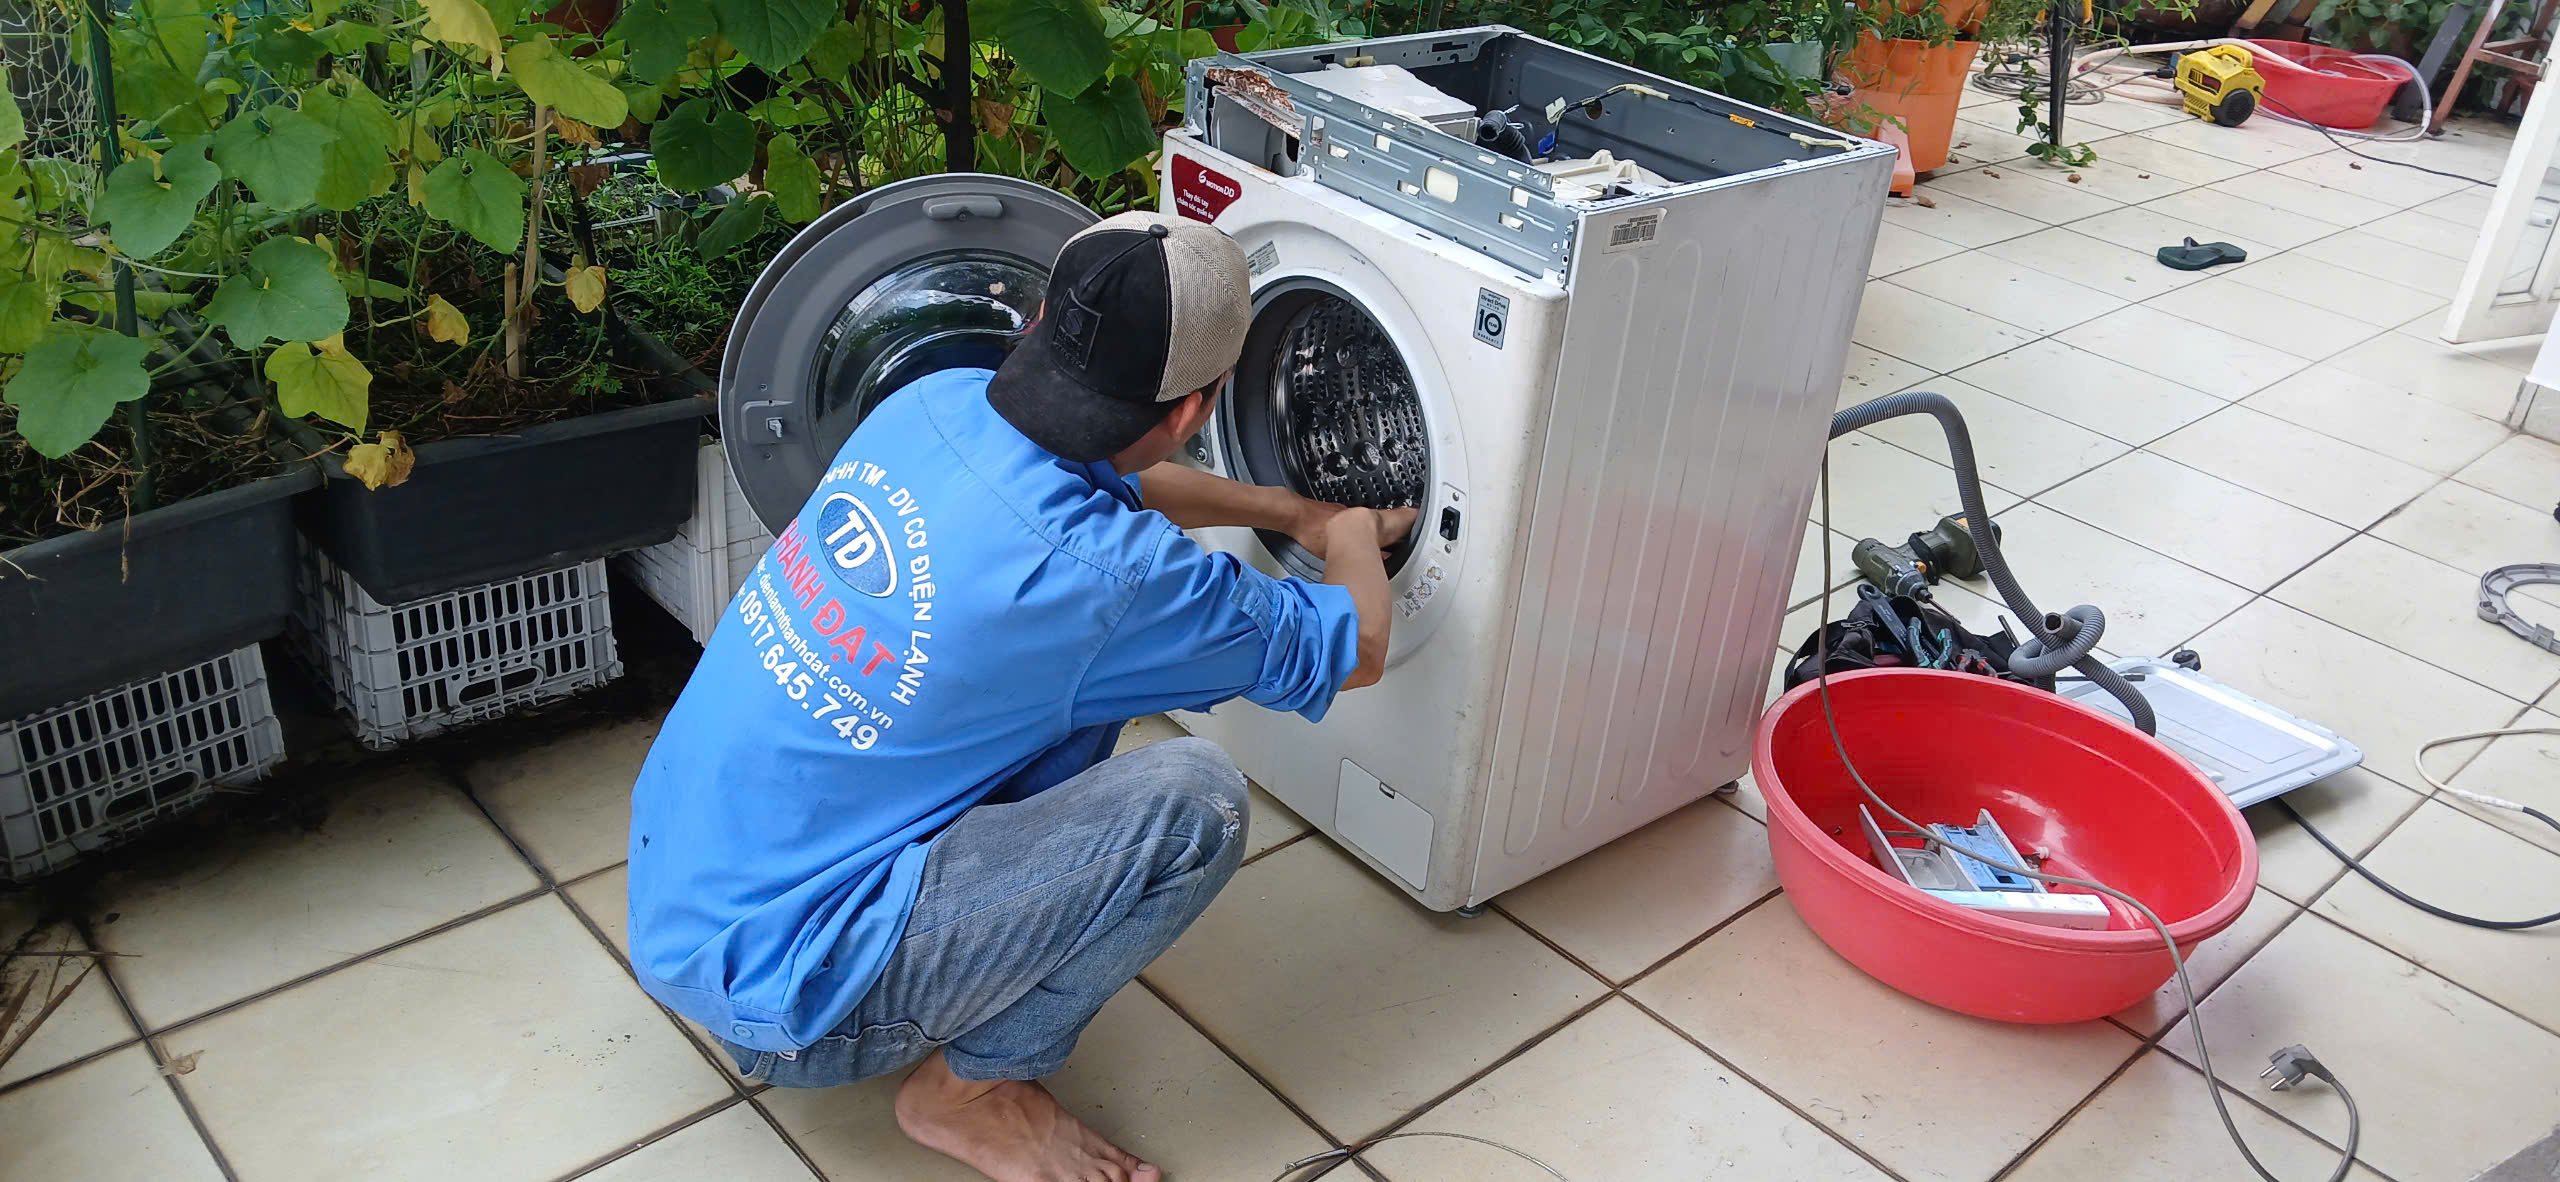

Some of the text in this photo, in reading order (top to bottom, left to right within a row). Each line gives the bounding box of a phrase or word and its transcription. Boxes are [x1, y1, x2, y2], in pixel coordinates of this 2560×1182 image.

[1478, 308, 1502, 336] 10
[858, 462, 887, 487] TM
[888, 488, 919, 519] DV
[908, 554, 938, 622] ĐIỆN
[738, 588, 880, 751] 0917.645.749
[811, 597, 897, 678] ĐẠT
[890, 631, 932, 706] LẠNH
